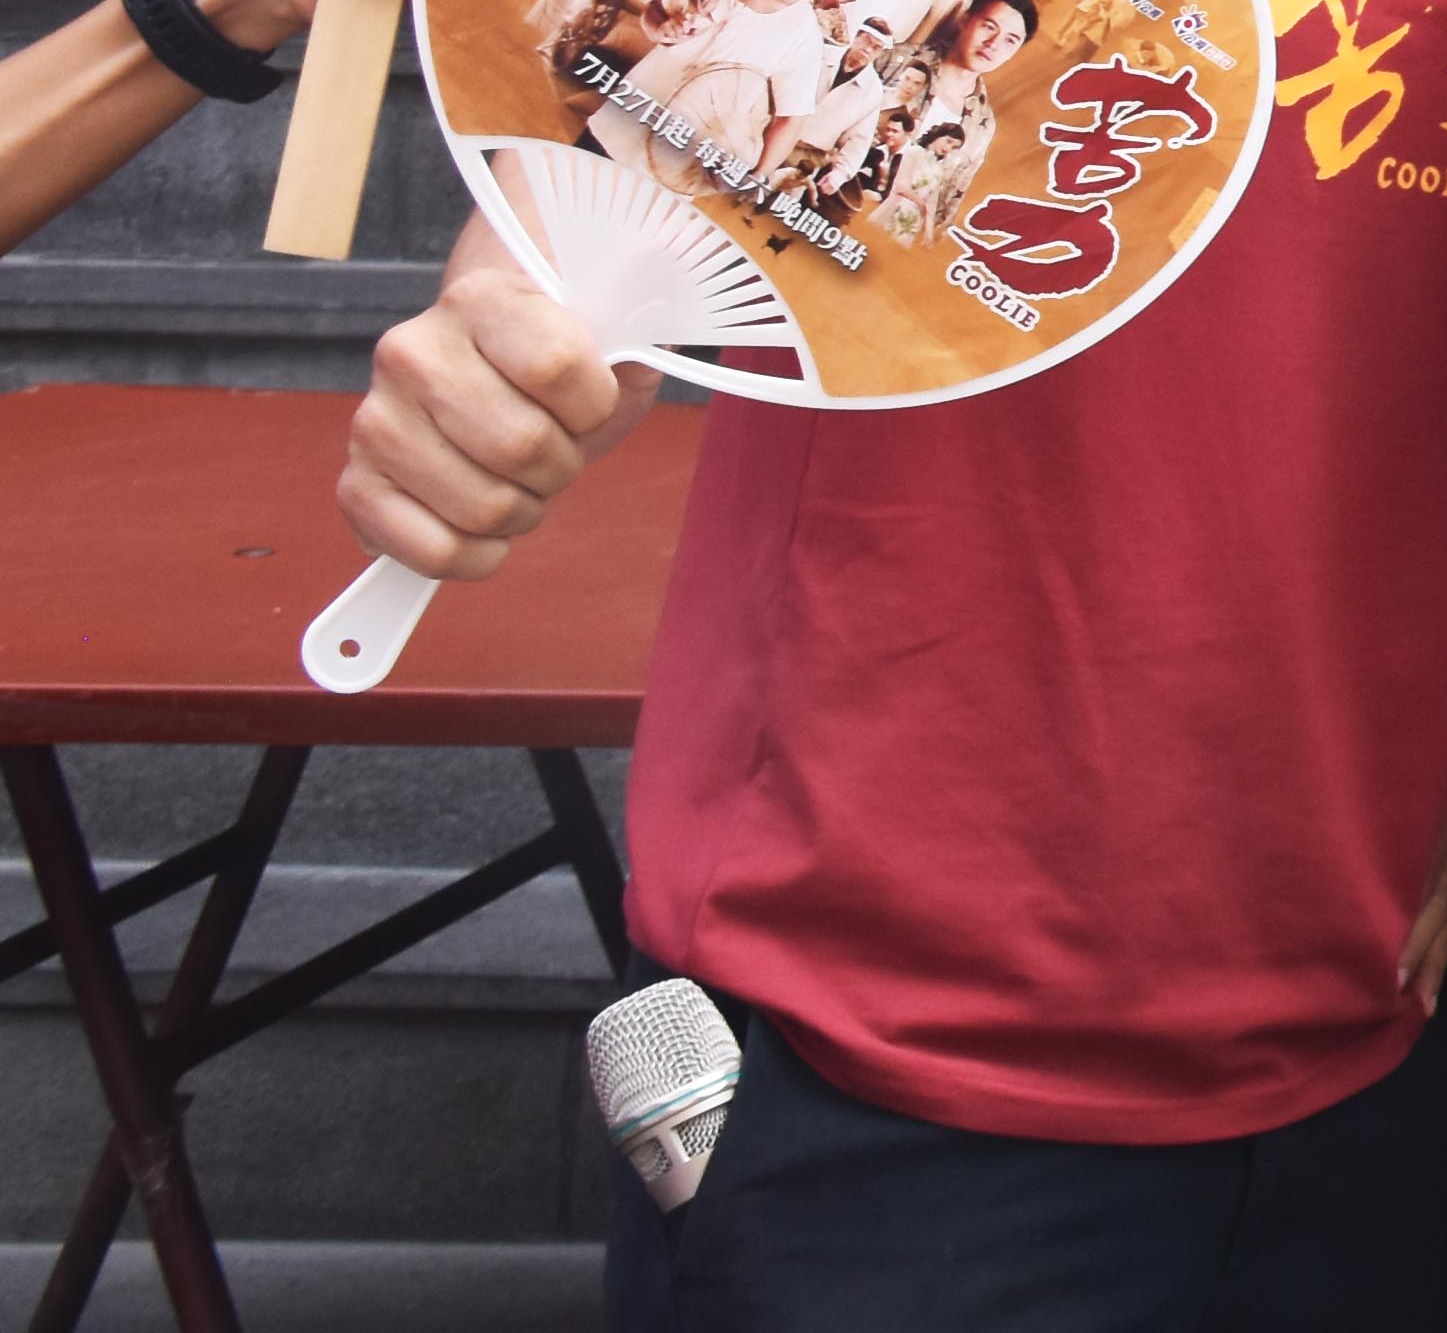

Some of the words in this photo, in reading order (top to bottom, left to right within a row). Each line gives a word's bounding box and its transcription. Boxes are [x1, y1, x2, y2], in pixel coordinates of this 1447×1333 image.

[574, 51, 696, 150] 7月27日起
[695, 137, 772, 205] 每週六
[769, 191, 868, 271] 晚間9點
[950, 264, 1036, 328] COOLIE
